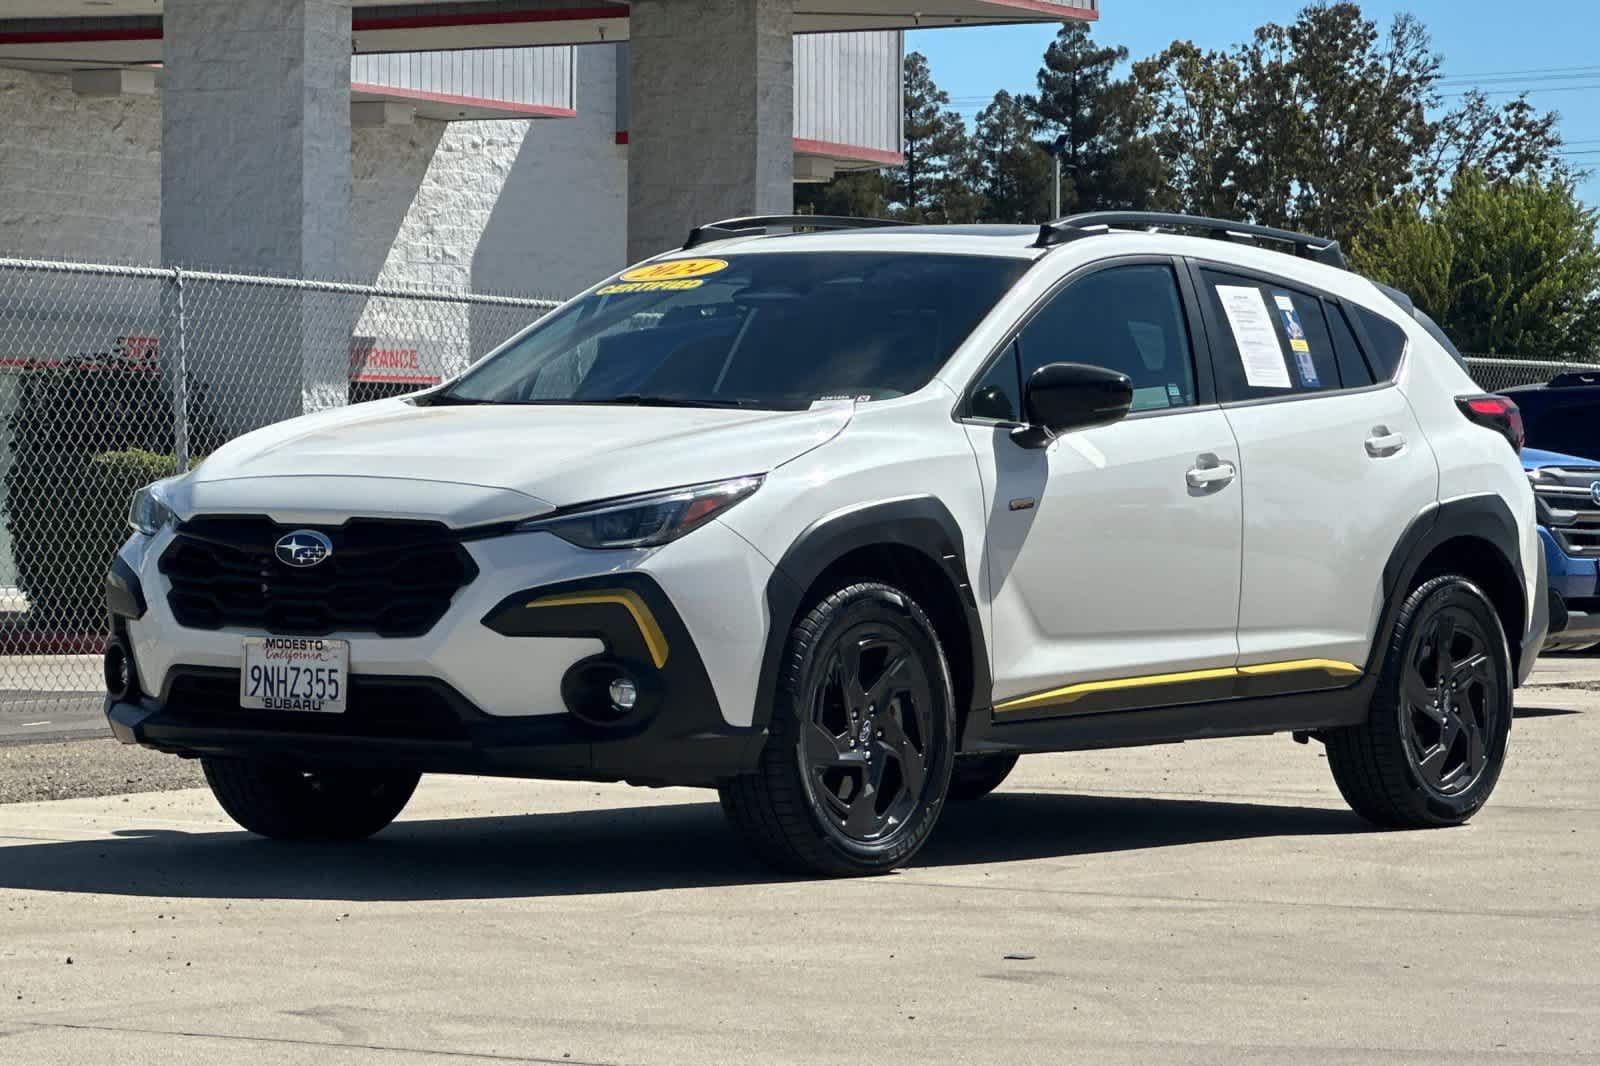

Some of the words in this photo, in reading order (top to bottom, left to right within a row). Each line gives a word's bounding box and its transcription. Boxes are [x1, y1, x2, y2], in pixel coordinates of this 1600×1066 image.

[265, 638, 323, 651] MODESTO
[265, 649, 326, 664] California
[250, 665, 339, 700] 9NHZ355
